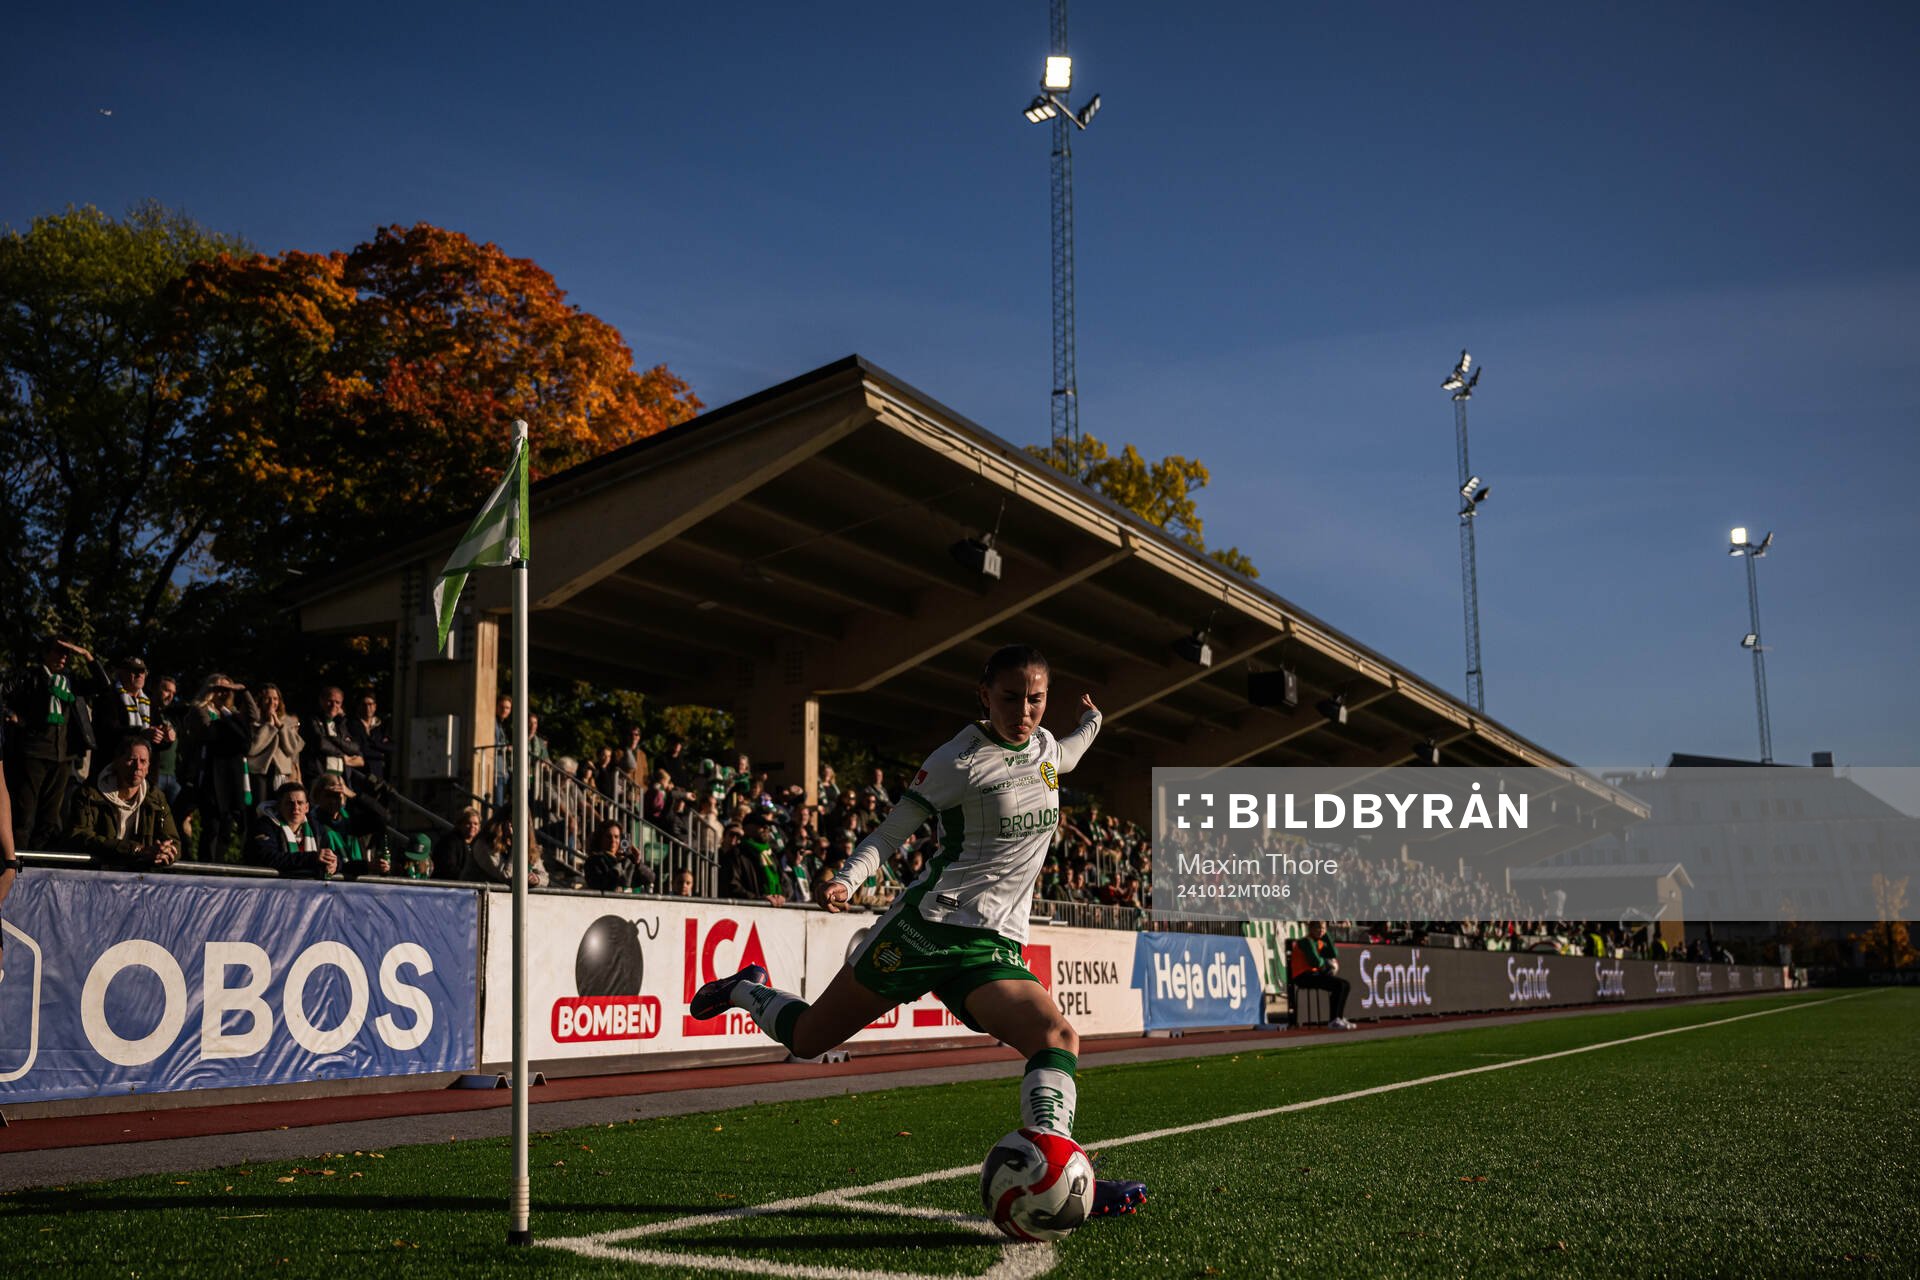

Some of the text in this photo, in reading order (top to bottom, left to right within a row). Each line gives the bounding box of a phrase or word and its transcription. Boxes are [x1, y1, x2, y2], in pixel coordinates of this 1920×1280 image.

[1000, 808, 1057, 834] PROJOB
[683, 918, 773, 1004] ICA
[1057, 960, 1119, 985] SVENSKA
[1154, 951, 1204, 1009] Heja
[1207, 952, 1247, 1009] dig!
[1360, 949, 1431, 1008] Scandic
[1507, 956, 1551, 1001] Scandic
[81, 939, 434, 1066] OBOS
[558, 1003, 657, 1038] BOMBEN
[1058, 991, 1092, 1016] SPEL
